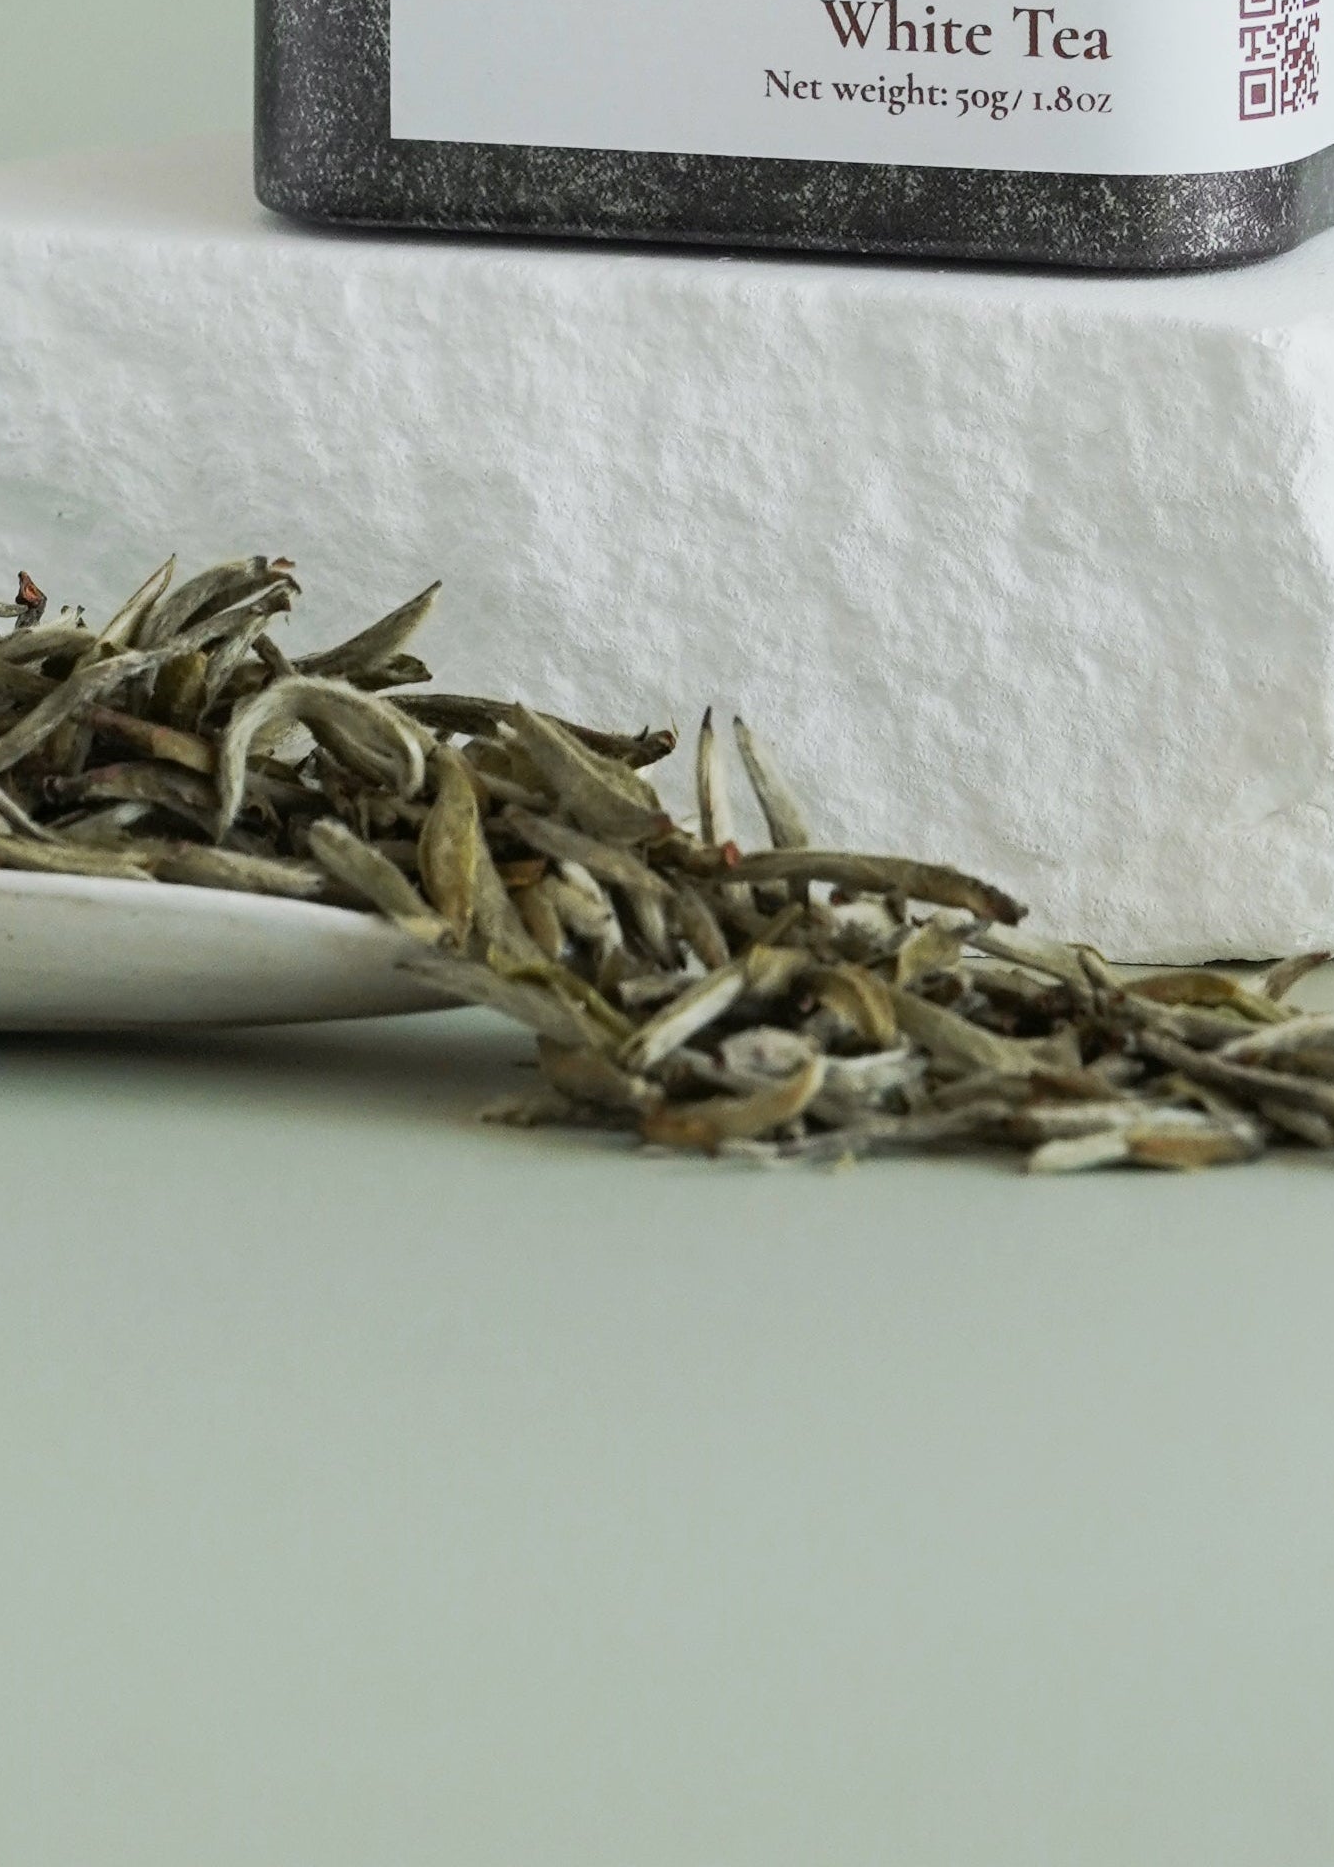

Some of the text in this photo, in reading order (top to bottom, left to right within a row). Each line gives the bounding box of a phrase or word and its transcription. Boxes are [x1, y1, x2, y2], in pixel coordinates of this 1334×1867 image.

[1012, 6, 1113, 61] Tea
[764, 68, 823, 101] Net
[832, 73, 949, 117] weight:
[1031, 85, 1113, 115] 1.8oz
